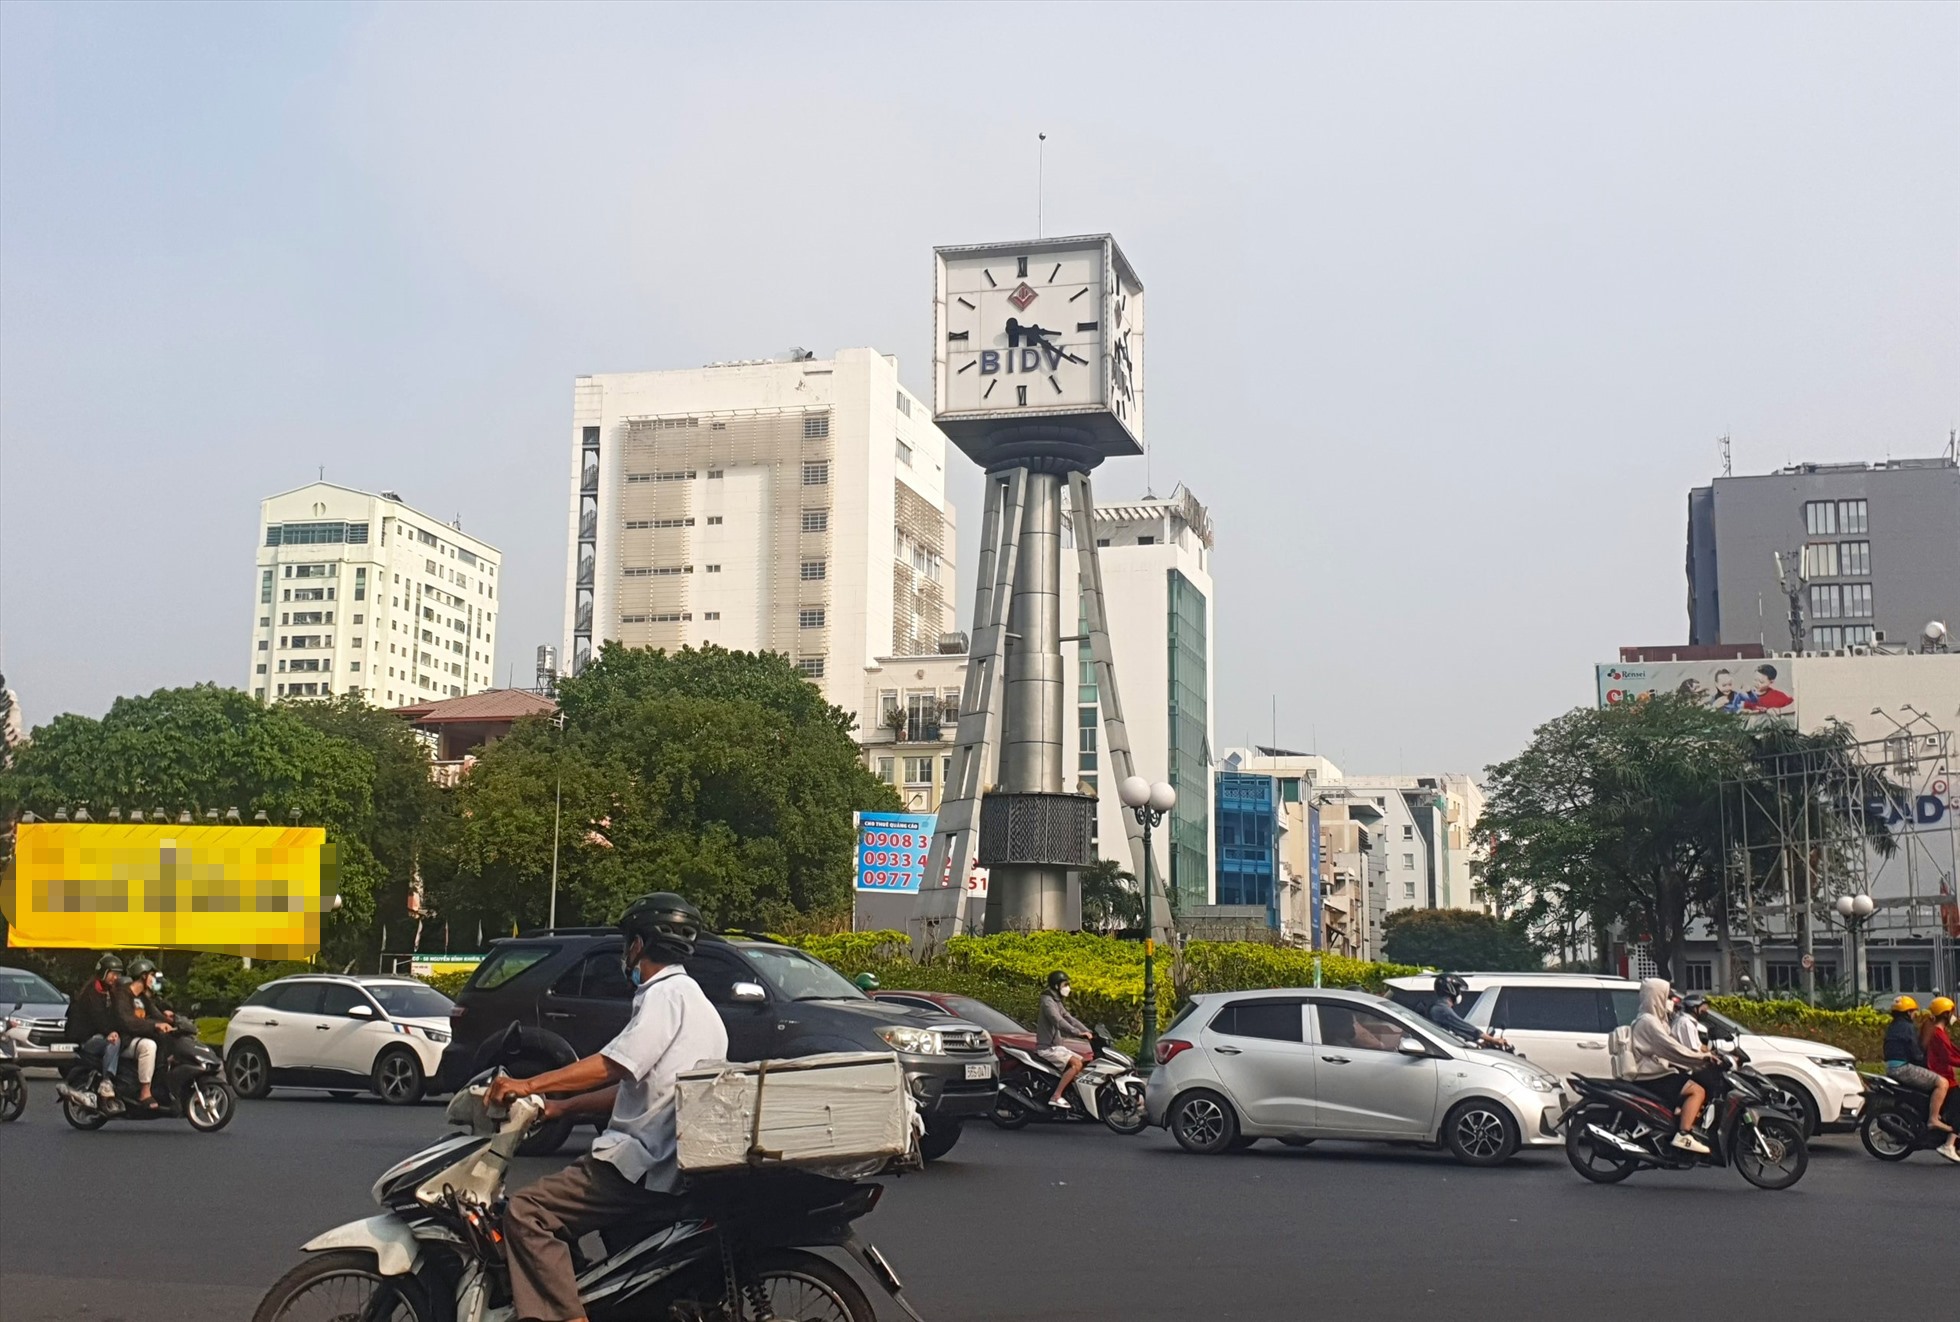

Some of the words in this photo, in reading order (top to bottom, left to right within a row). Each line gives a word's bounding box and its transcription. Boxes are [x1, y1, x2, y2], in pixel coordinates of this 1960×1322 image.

[980, 345, 1064, 375] BIDV
[864, 832, 913, 849] 0908
[864, 852, 912, 867] 0933
[863, 871, 911, 887] 0977
[395, 1203, 420, 1211] HONDA
